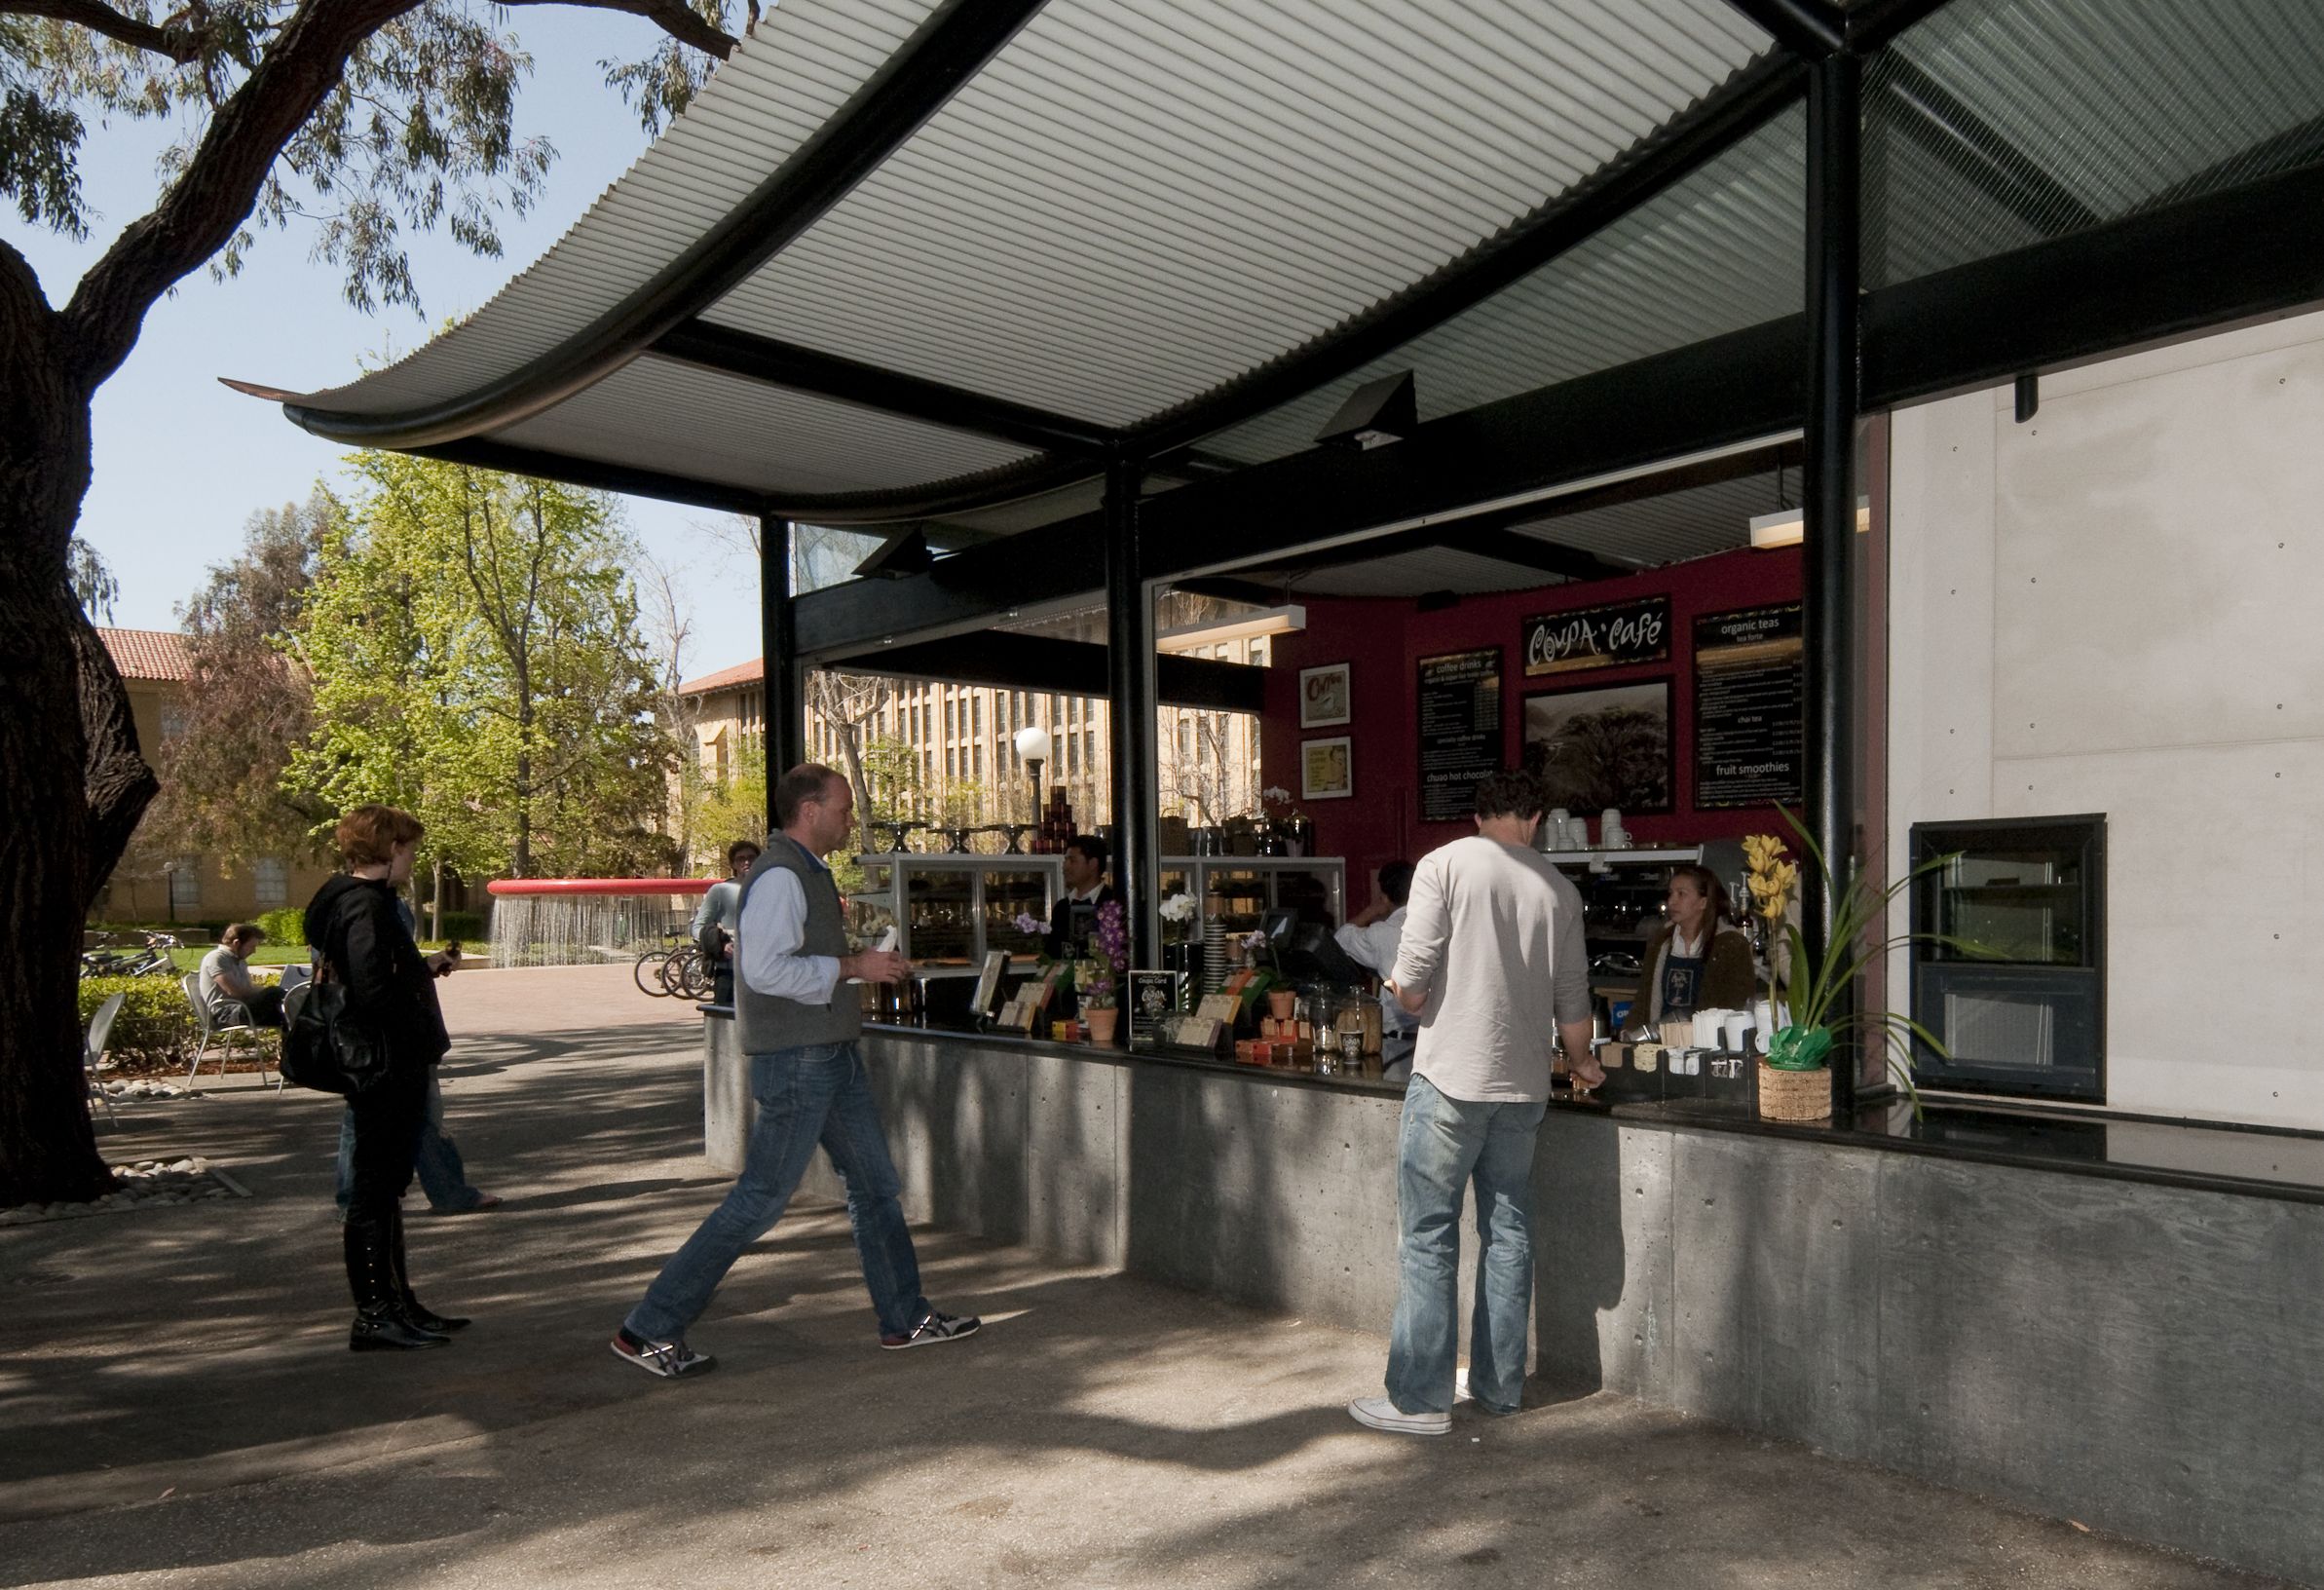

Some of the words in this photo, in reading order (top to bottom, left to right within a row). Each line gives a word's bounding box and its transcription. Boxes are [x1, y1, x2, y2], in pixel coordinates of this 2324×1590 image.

[1721, 620, 1756, 635] organic
[1758, 618, 1780, 629] teas
[1437, 662, 1459, 673] coffee
[1459, 660, 1481, 670] drinks
[1449, 771, 1461, 780] hot
[1716, 764, 1737, 776] fruit
[1739, 761, 1789, 774] smoothies
